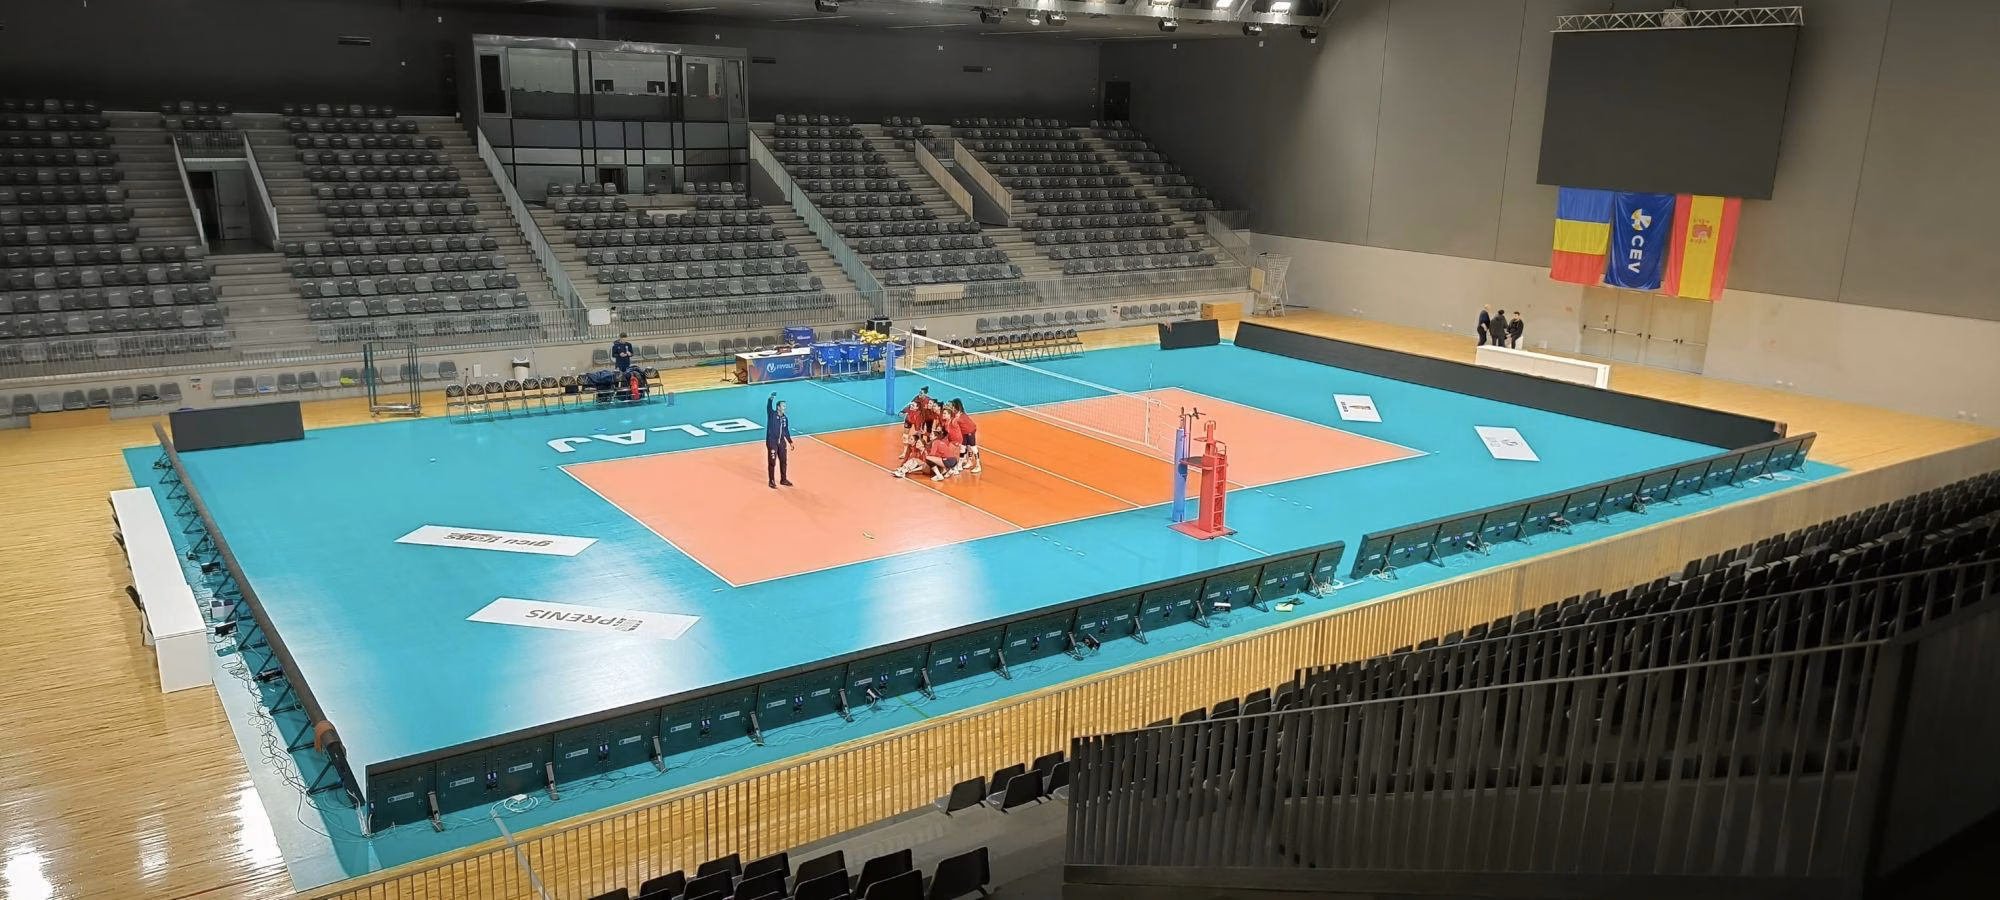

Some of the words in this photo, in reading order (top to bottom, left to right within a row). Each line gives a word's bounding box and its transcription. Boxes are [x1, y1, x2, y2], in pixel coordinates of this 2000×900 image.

[1628, 235, 1644, 273] CEV
[546, 418, 765, 453] BLAJ
[525, 609, 619, 626] PRENIS
